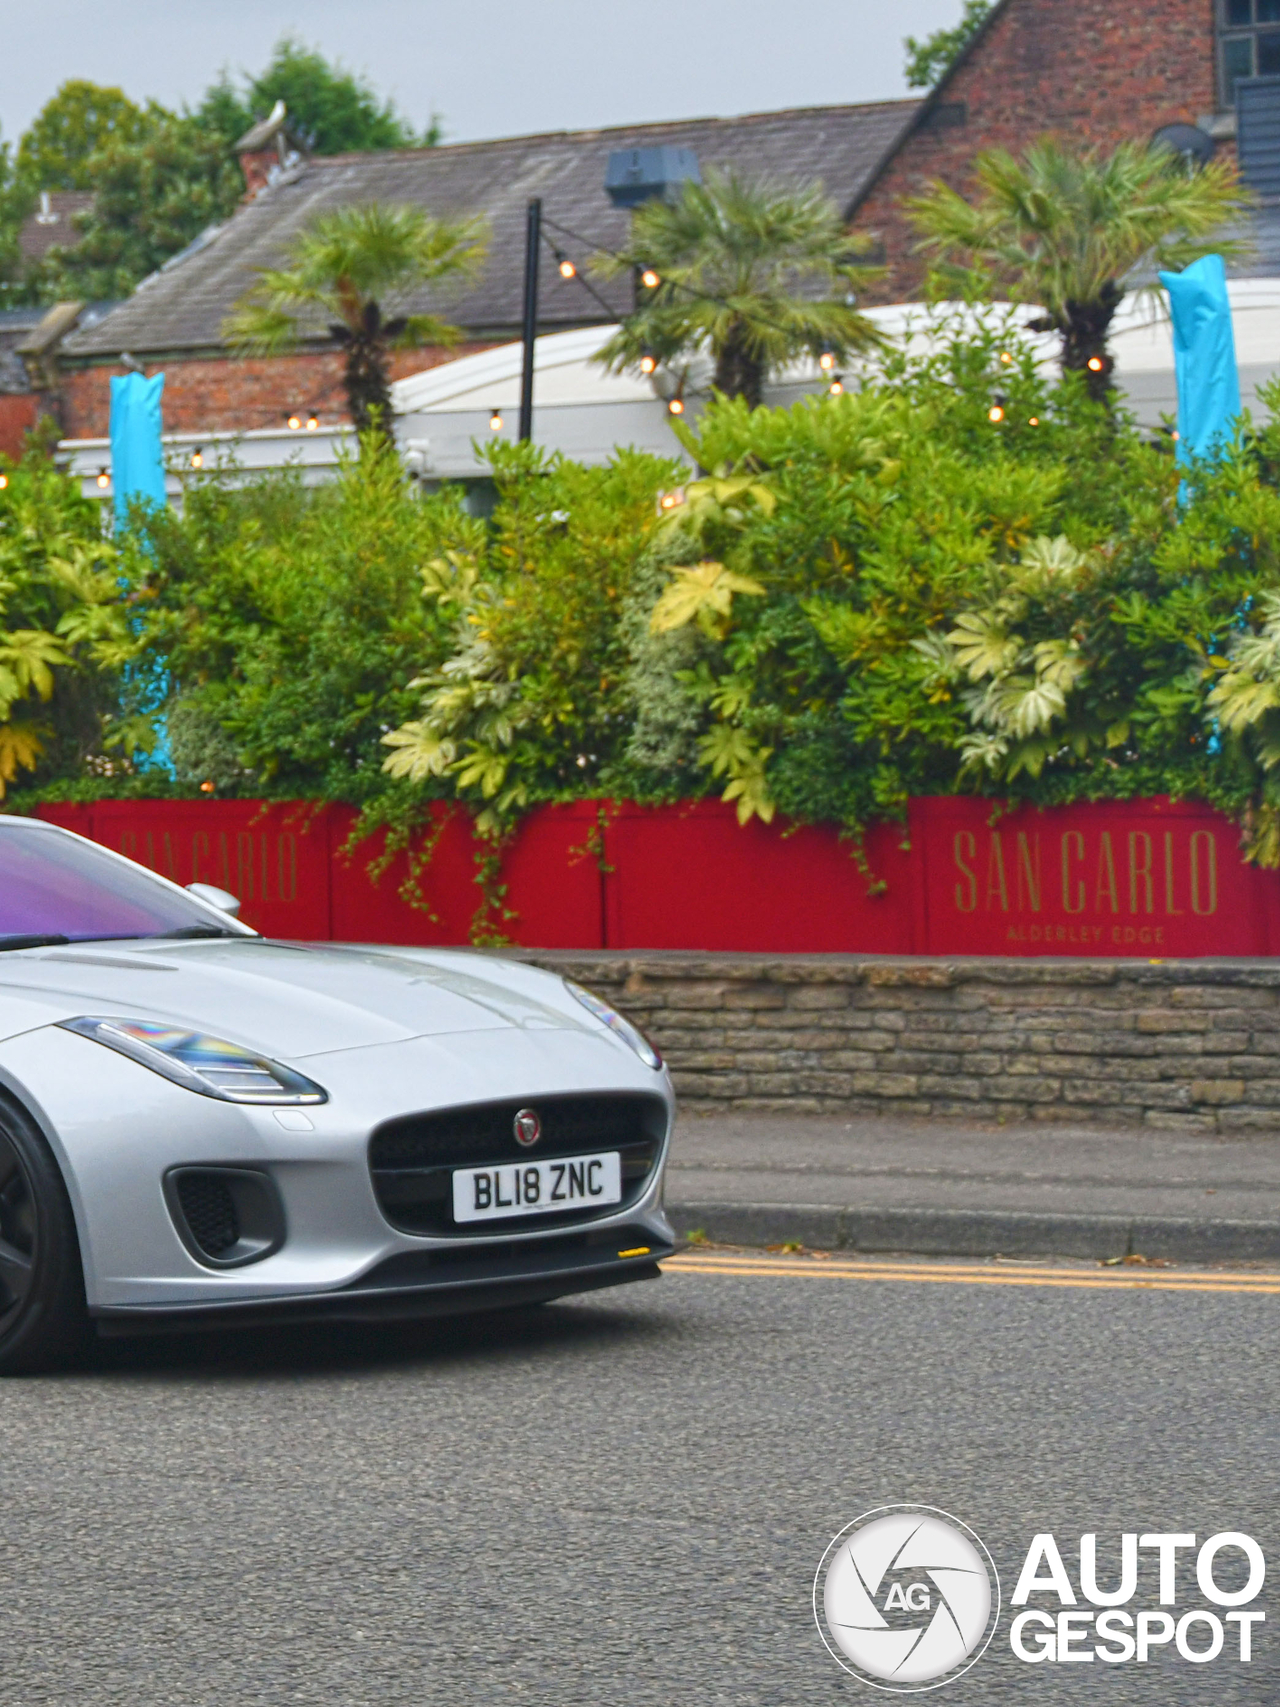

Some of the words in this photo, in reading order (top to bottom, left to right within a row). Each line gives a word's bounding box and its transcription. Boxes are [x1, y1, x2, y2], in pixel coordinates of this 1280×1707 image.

[193, 830, 296, 901] CARLO
[954, 830, 1040, 912] SAN
[1061, 829, 1217, 915] CARLO
[1007, 925, 1102, 942] ALDERLEY
[1112, 926, 1164, 944] EDGE
[474, 1167, 540, 1210] BL18
[550, 1160, 602, 1200] ZNC
